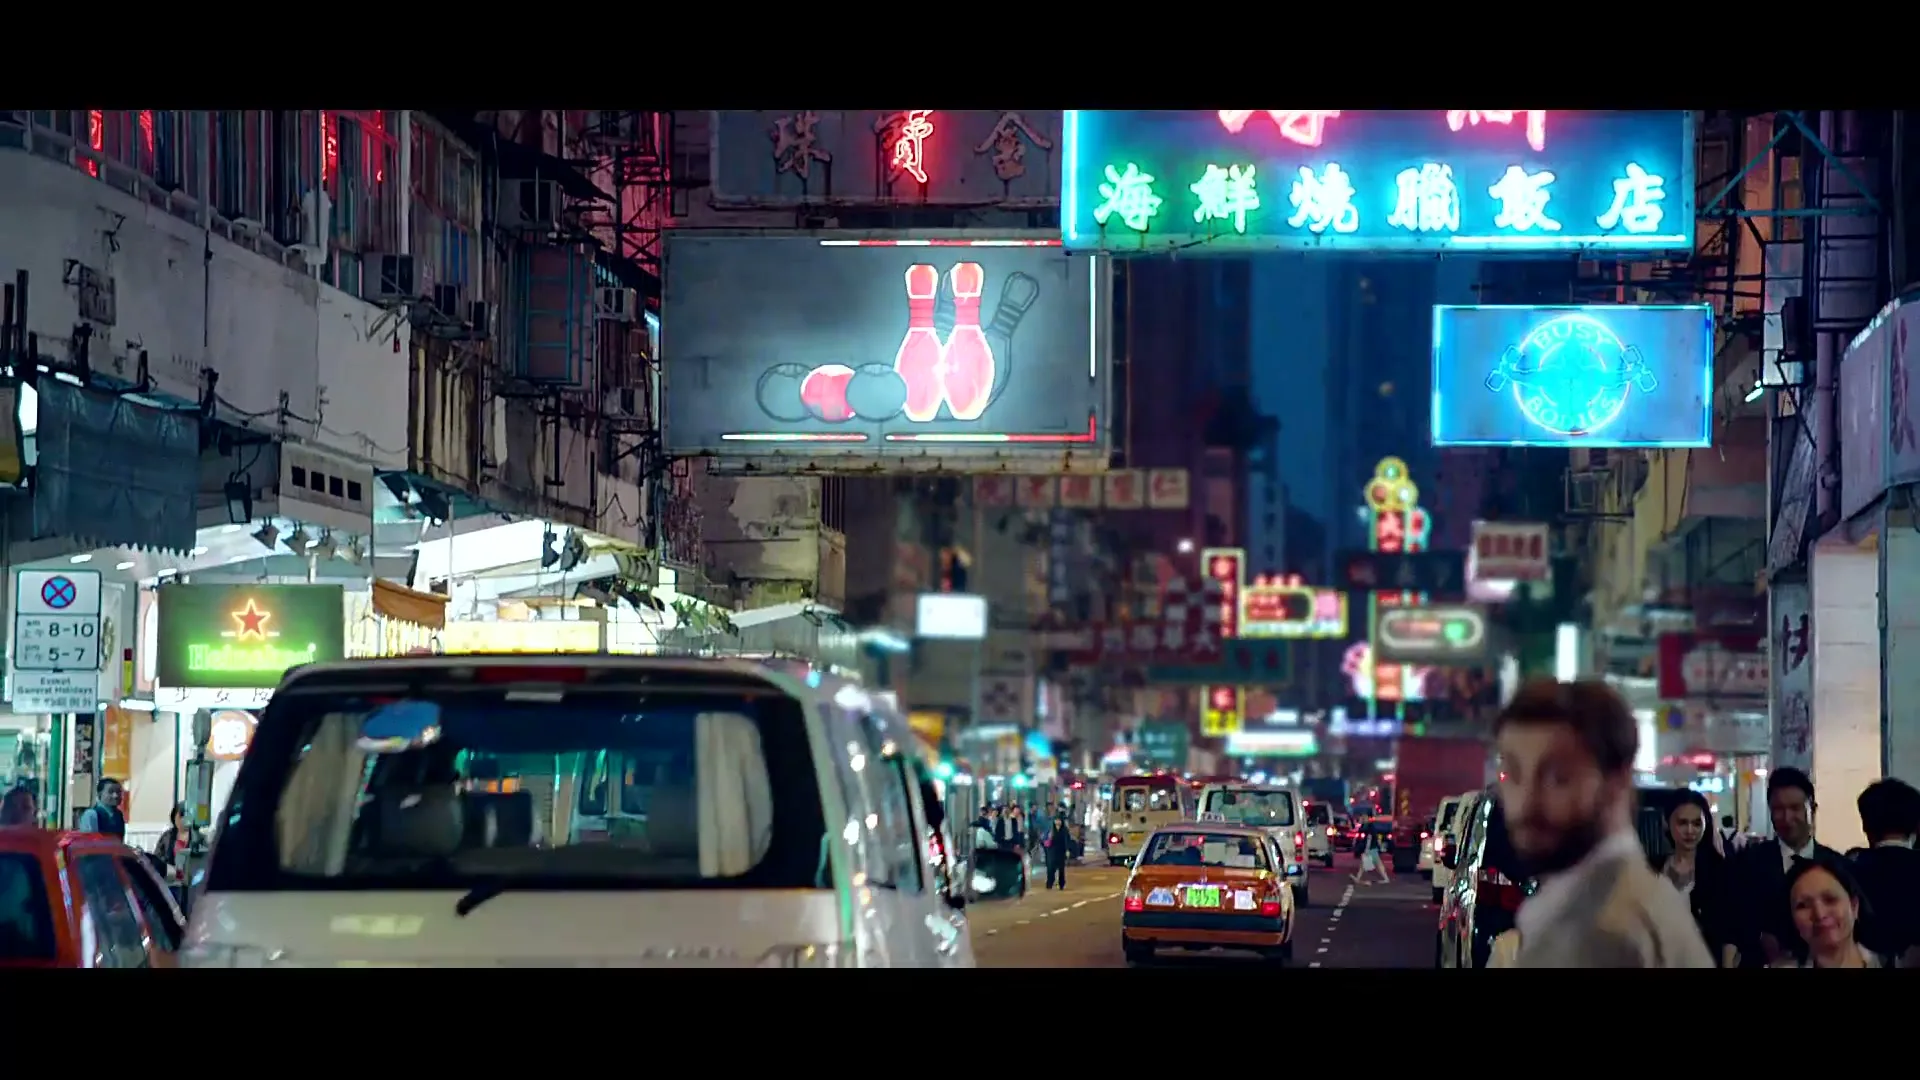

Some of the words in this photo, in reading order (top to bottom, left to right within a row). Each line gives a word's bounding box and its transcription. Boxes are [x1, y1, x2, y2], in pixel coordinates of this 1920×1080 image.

[1532, 321, 1614, 349] BUSY
[48, 622, 94, 637] 8-10
[48, 647, 85, 661] 5-7
